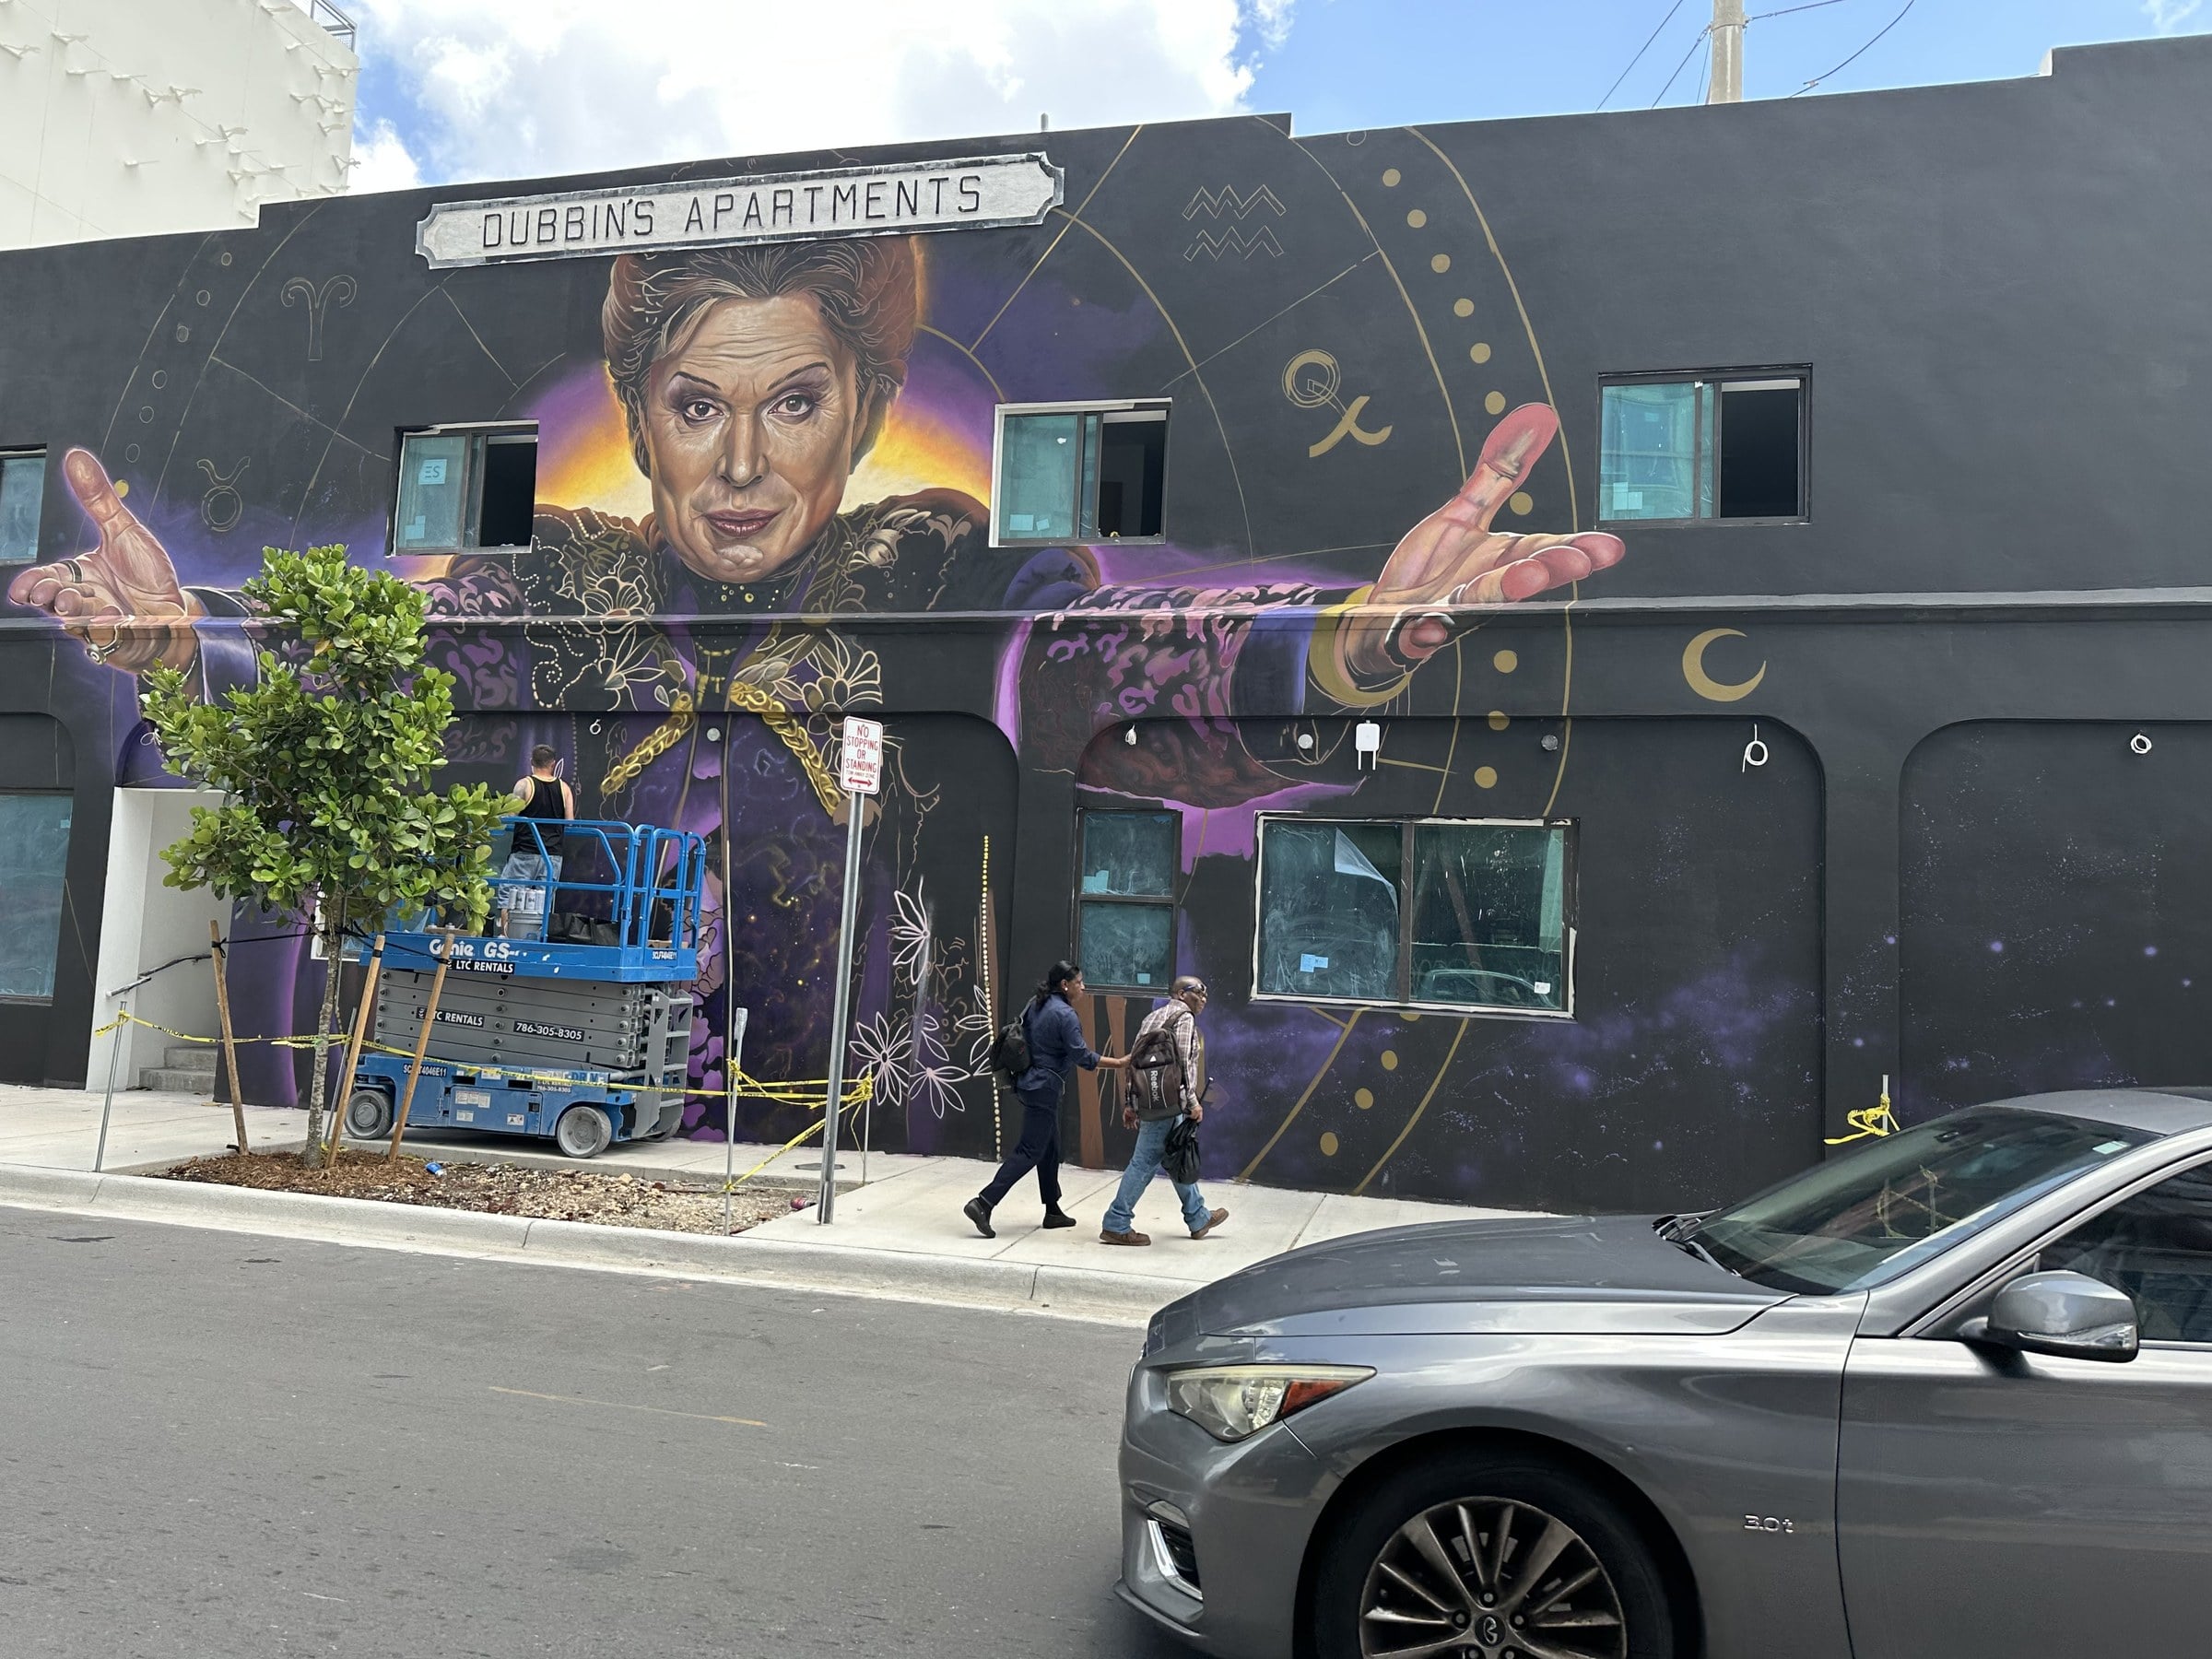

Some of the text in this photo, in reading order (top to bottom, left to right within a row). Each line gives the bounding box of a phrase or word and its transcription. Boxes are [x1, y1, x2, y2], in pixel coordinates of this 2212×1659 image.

[483, 175, 982, 248] DUBBIN'S APARTMENTS
[856, 724, 869, 737] NO
[846, 735, 878, 751] STOPPING
[856, 748, 866, 759] OR
[845, 758, 877, 773] STANDING
[429, 938, 475, 957] Gnie
[456, 959, 514, 973] LTC RENTALS
[430, 1010, 484, 1027] TC RENTALS
[516, 1022, 582, 1041] 786-305-8305
[1150, 1070, 1159, 1102] Reebok
